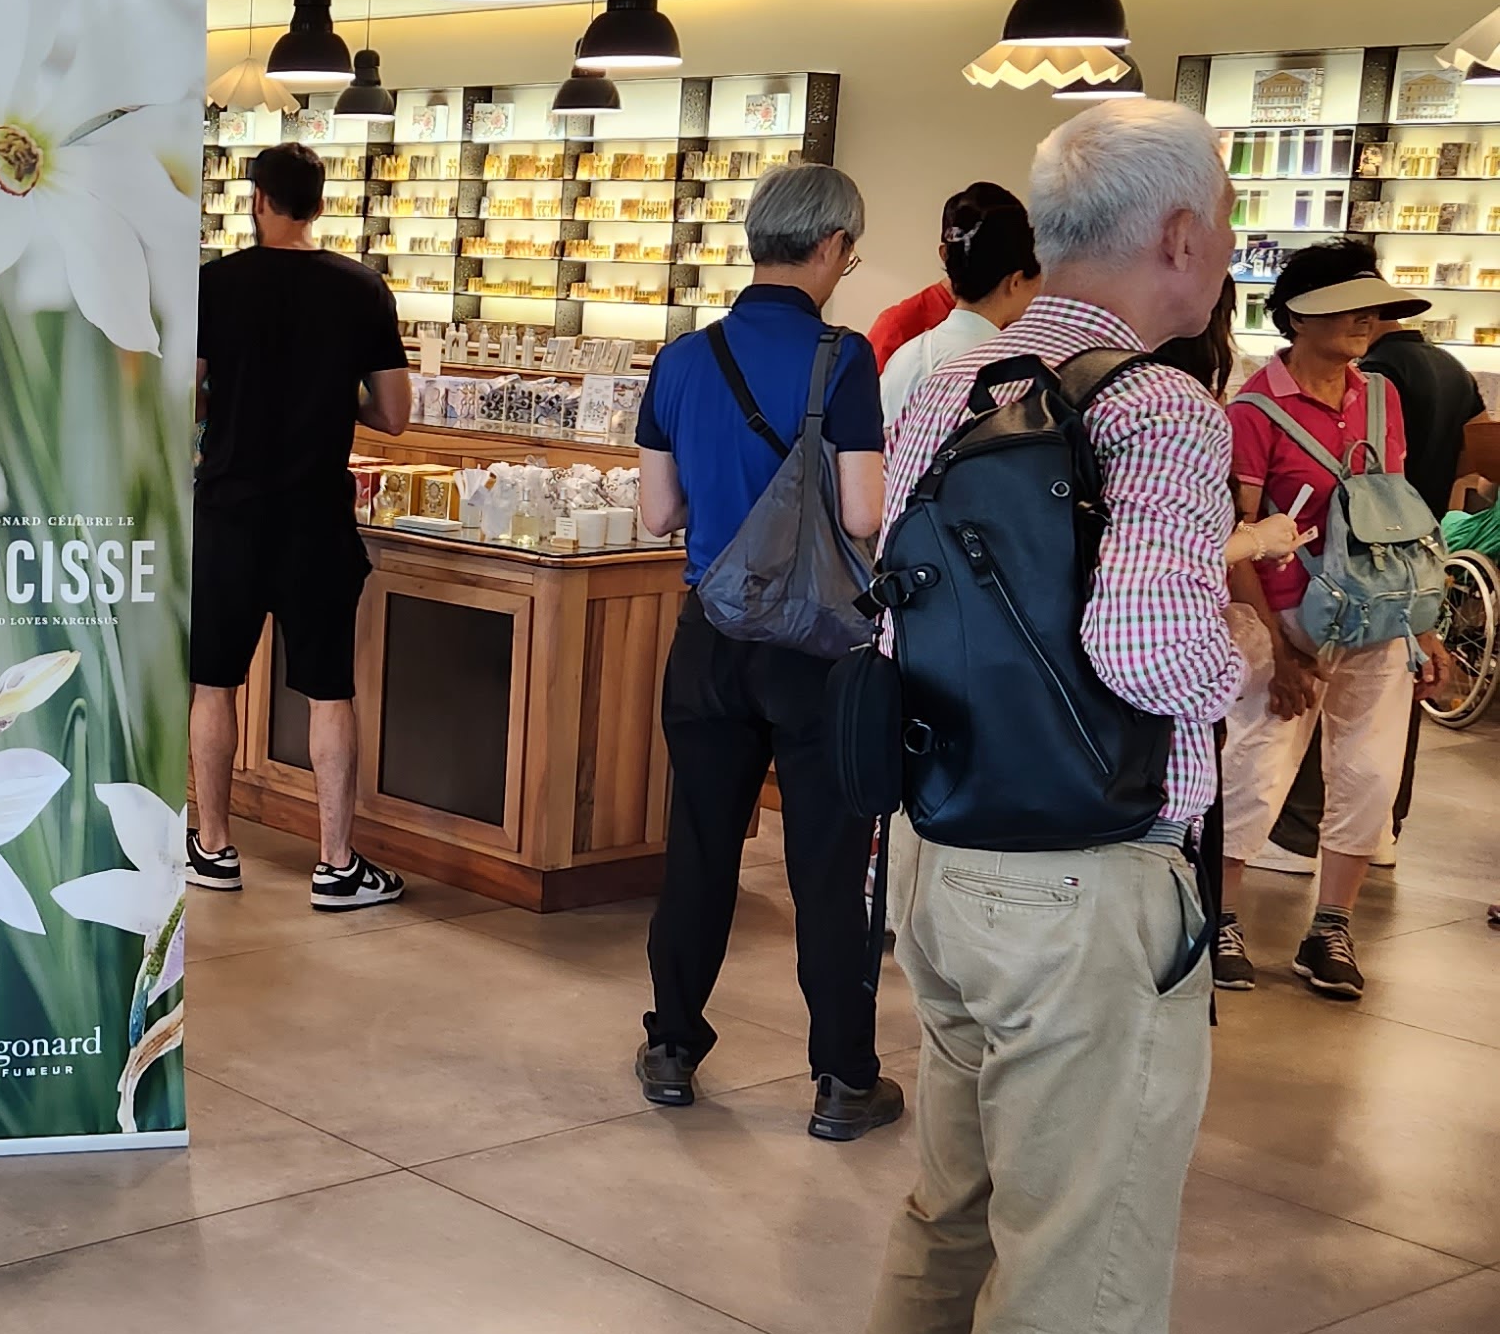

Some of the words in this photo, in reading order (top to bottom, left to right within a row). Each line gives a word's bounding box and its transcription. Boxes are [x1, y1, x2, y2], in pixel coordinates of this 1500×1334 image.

[118, 516, 135, 527] LE
[10, 616, 48, 626] LOVES
[52, 616, 119, 626] NARCISSUS
